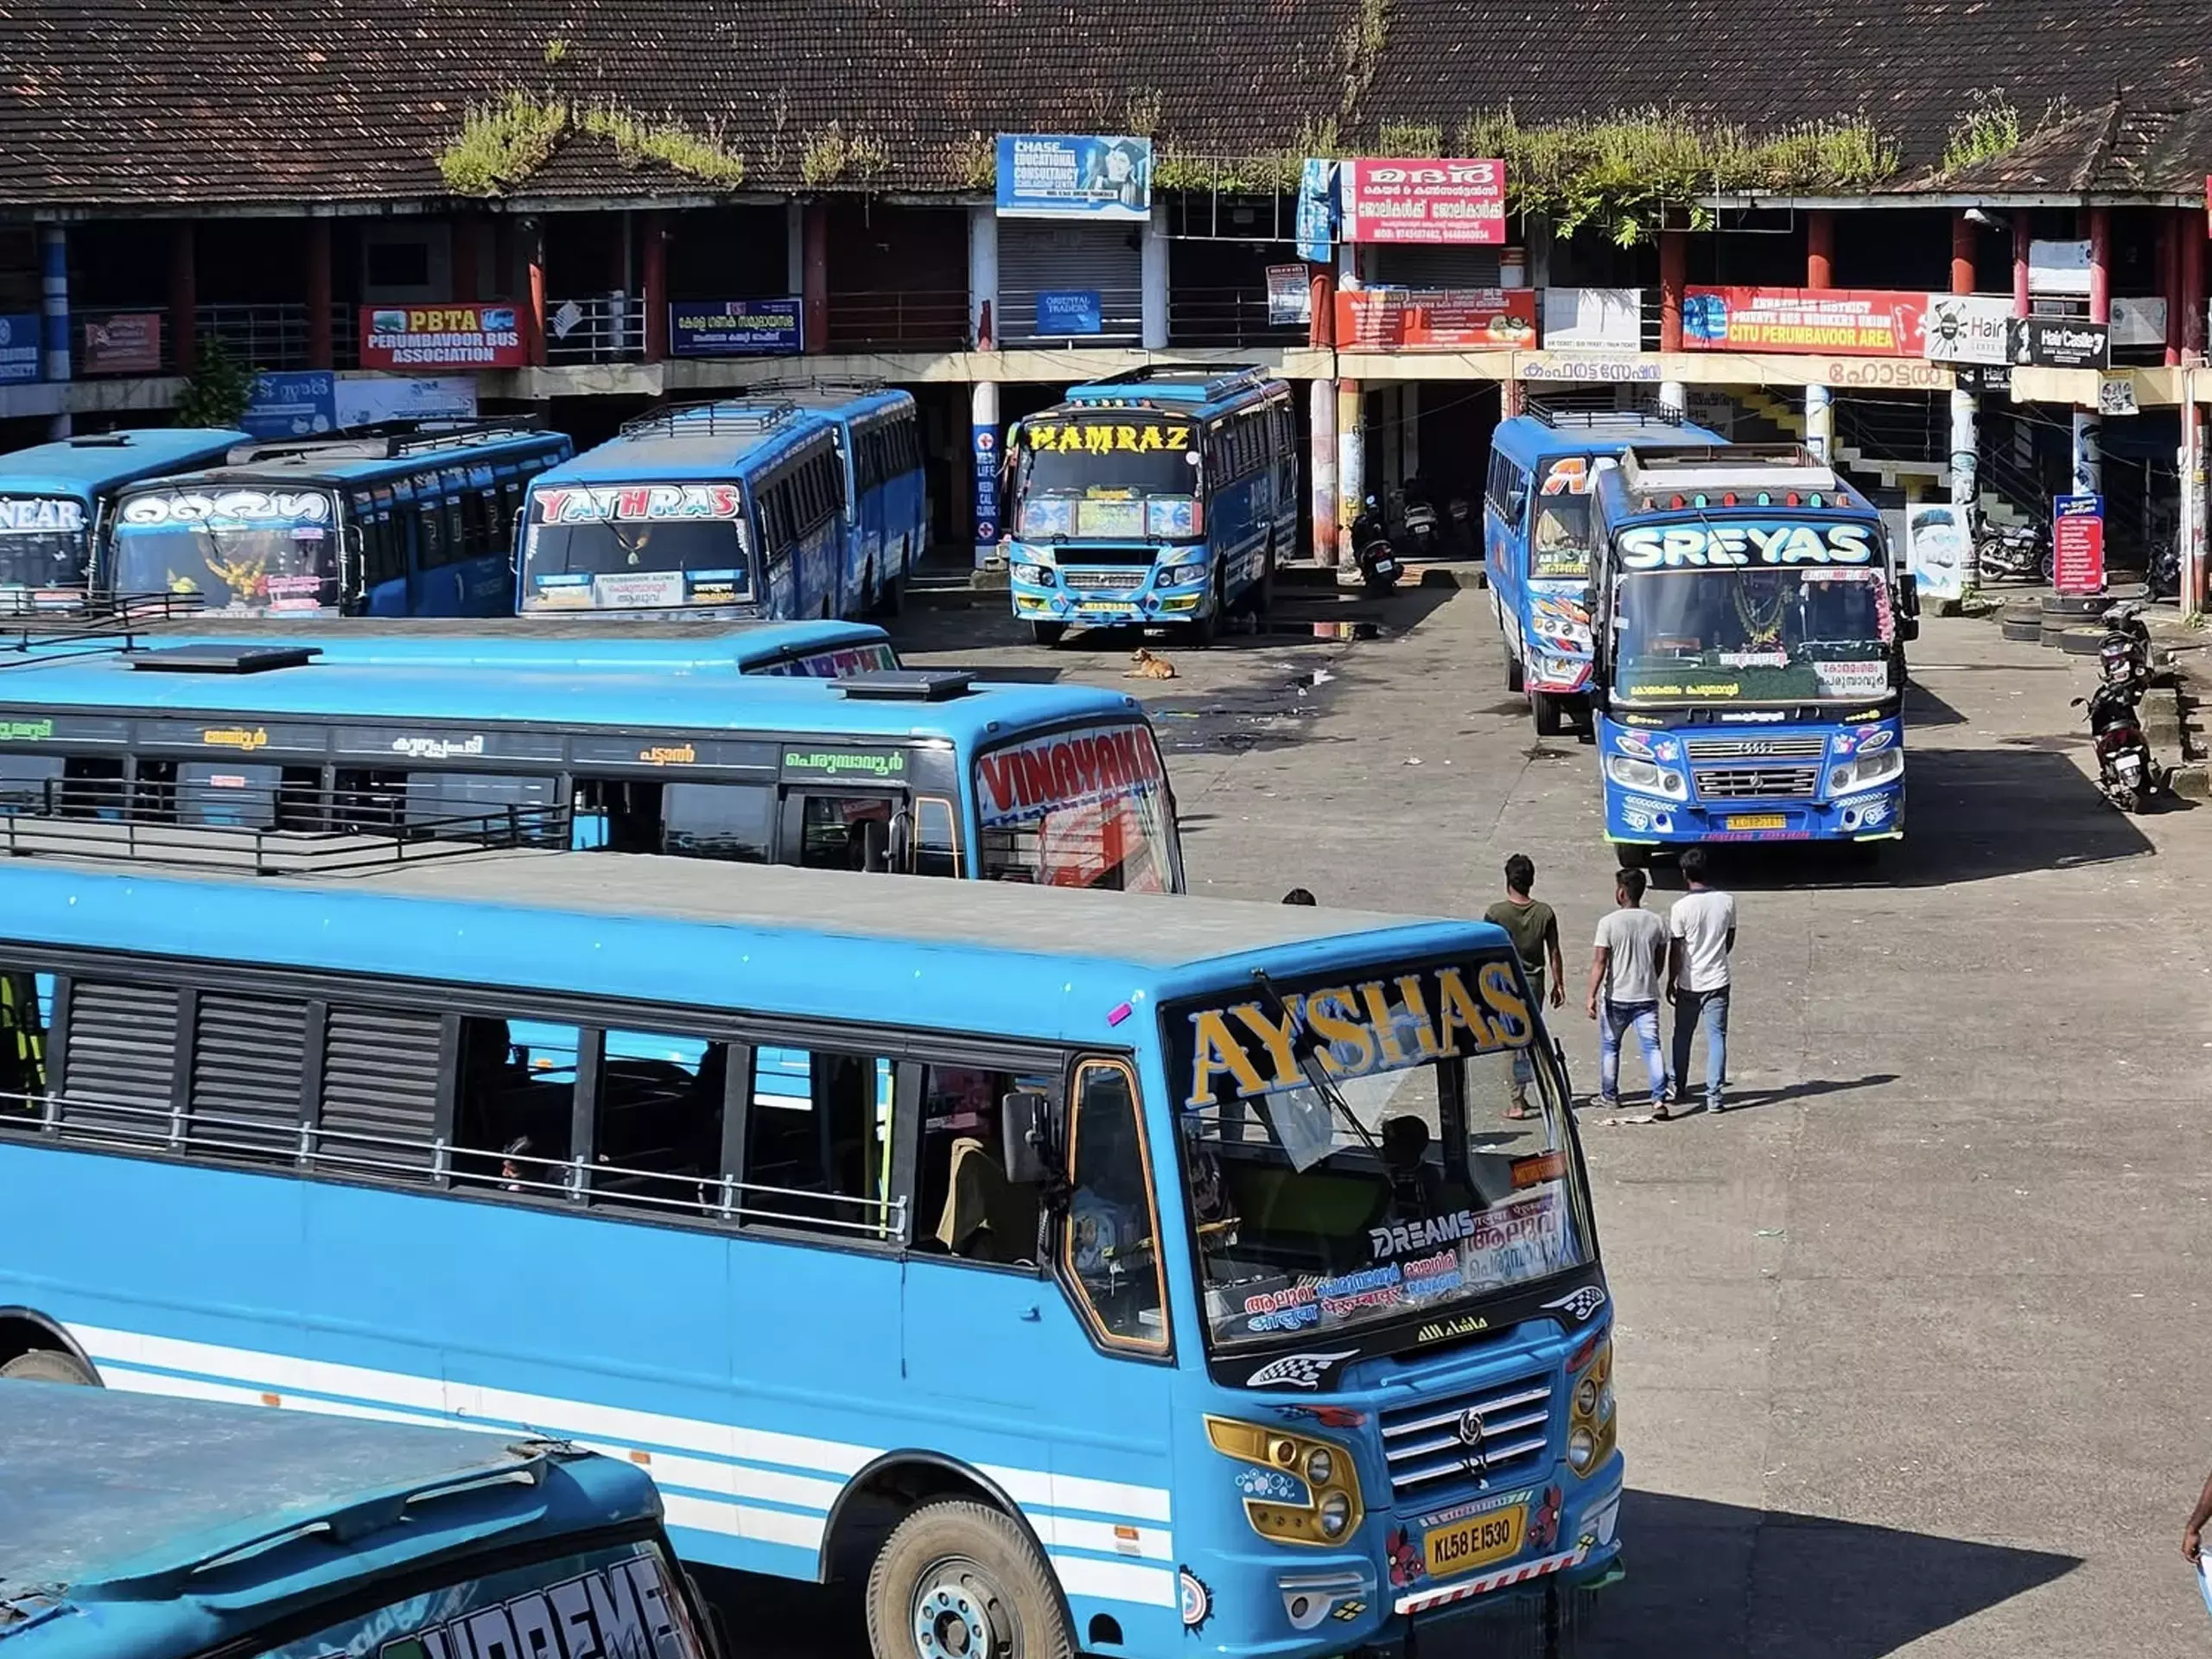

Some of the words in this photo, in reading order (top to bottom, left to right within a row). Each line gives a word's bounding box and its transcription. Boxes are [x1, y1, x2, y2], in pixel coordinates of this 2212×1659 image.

[1014, 142, 1061, 152] CHASE
[1014, 153, 1076, 167] EDUCATIONAL
[1014, 167, 1079, 181] CONSULTANCY
[1046, 296, 1090, 305] ORIENTAL
[1048, 304, 1089, 313] TRADERS
[410, 310, 478, 332] PBTA
[1972, 317, 2002, 338] Hair
[368, 334, 484, 347] PERUMBAVOOR
[486, 333, 518, 346] BUS
[1730, 325, 1759, 343] CITU
[1761, 326, 1856, 346] PERUMBAVOOR
[1859, 329, 1894, 348] AREA
[2041, 328, 2062, 346] Hair
[392, 347, 494, 363] ASSOCIATION
[534, 485, 741, 523] YATHRAS
[1623, 524, 1872, 569] SREYAS
[980, 725, 1160, 813] VINAYAKA
[1185, 961, 1533, 1109] AYSHAS
[1369, 1210, 1475, 1259] DREAMS
[1434, 1530, 1469, 1564] KL58
[1471, 1519, 1510, 1554] E1530
